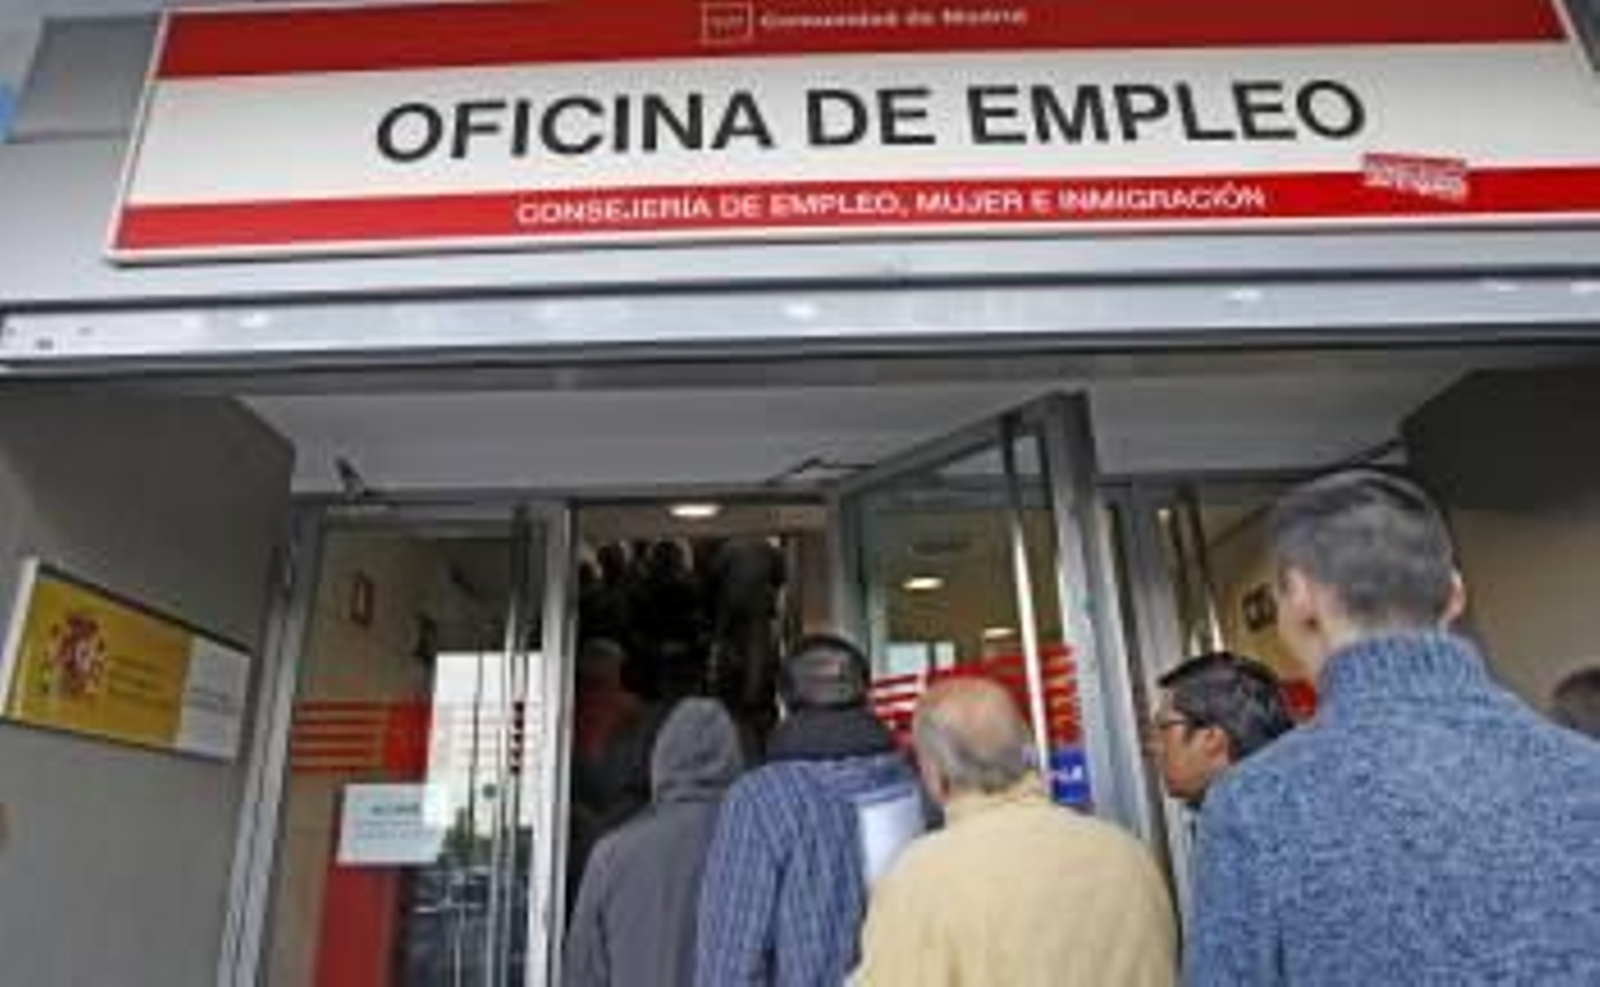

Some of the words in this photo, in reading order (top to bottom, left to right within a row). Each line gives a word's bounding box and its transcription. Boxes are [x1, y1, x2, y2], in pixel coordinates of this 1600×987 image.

[376, 90, 775, 163] OFICINA
[805, 86, 936, 147] DE
[966, 78, 1367, 145] EMPLEO
[720, 194, 762, 220] DE
[769, 190, 911, 218] EMPLEO,
[915, 190, 1024, 217] MUJER
[1031, 189, 1052, 212] E
[1057, 181, 1266, 212] INMIGRACIÓN
